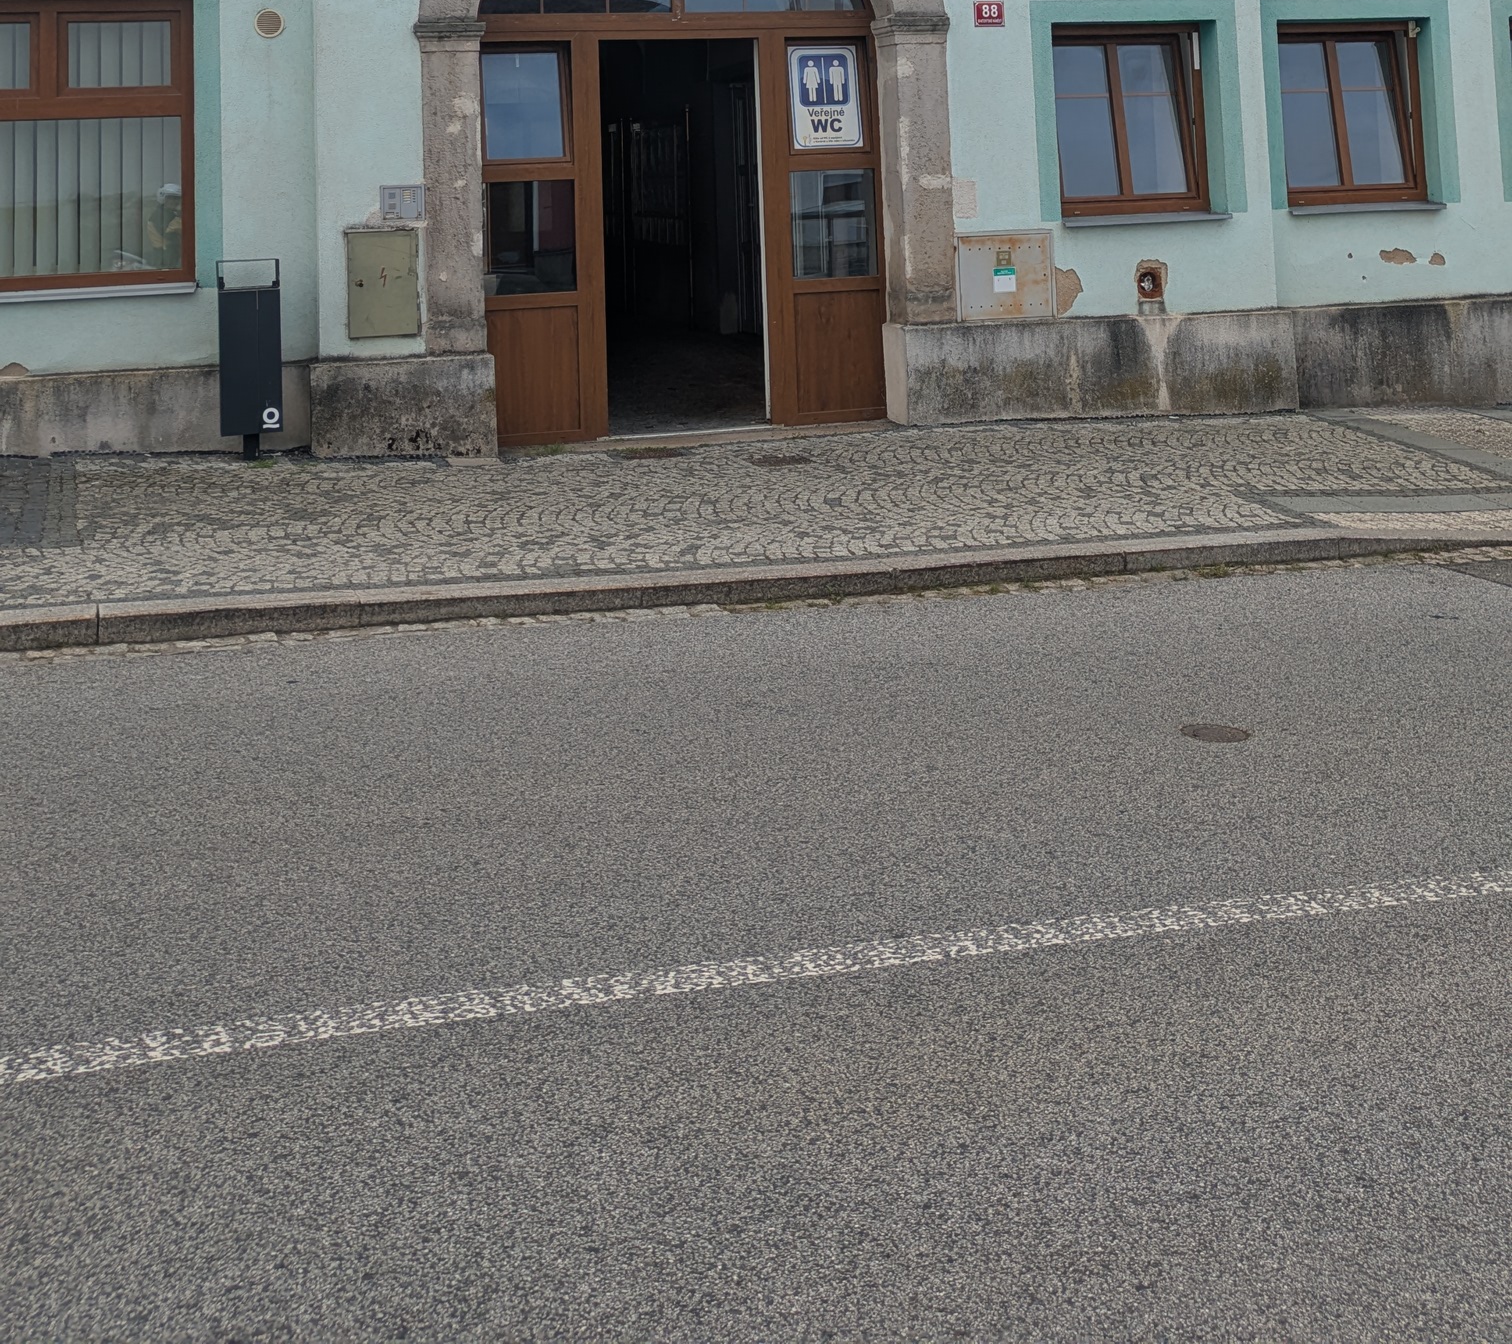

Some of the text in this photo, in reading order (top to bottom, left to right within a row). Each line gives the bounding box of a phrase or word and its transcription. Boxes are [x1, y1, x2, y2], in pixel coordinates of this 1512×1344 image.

[982, 4, 998, 17] 88
[807, 108, 845, 119] Veřejné
[810, 118, 843, 133] WC
